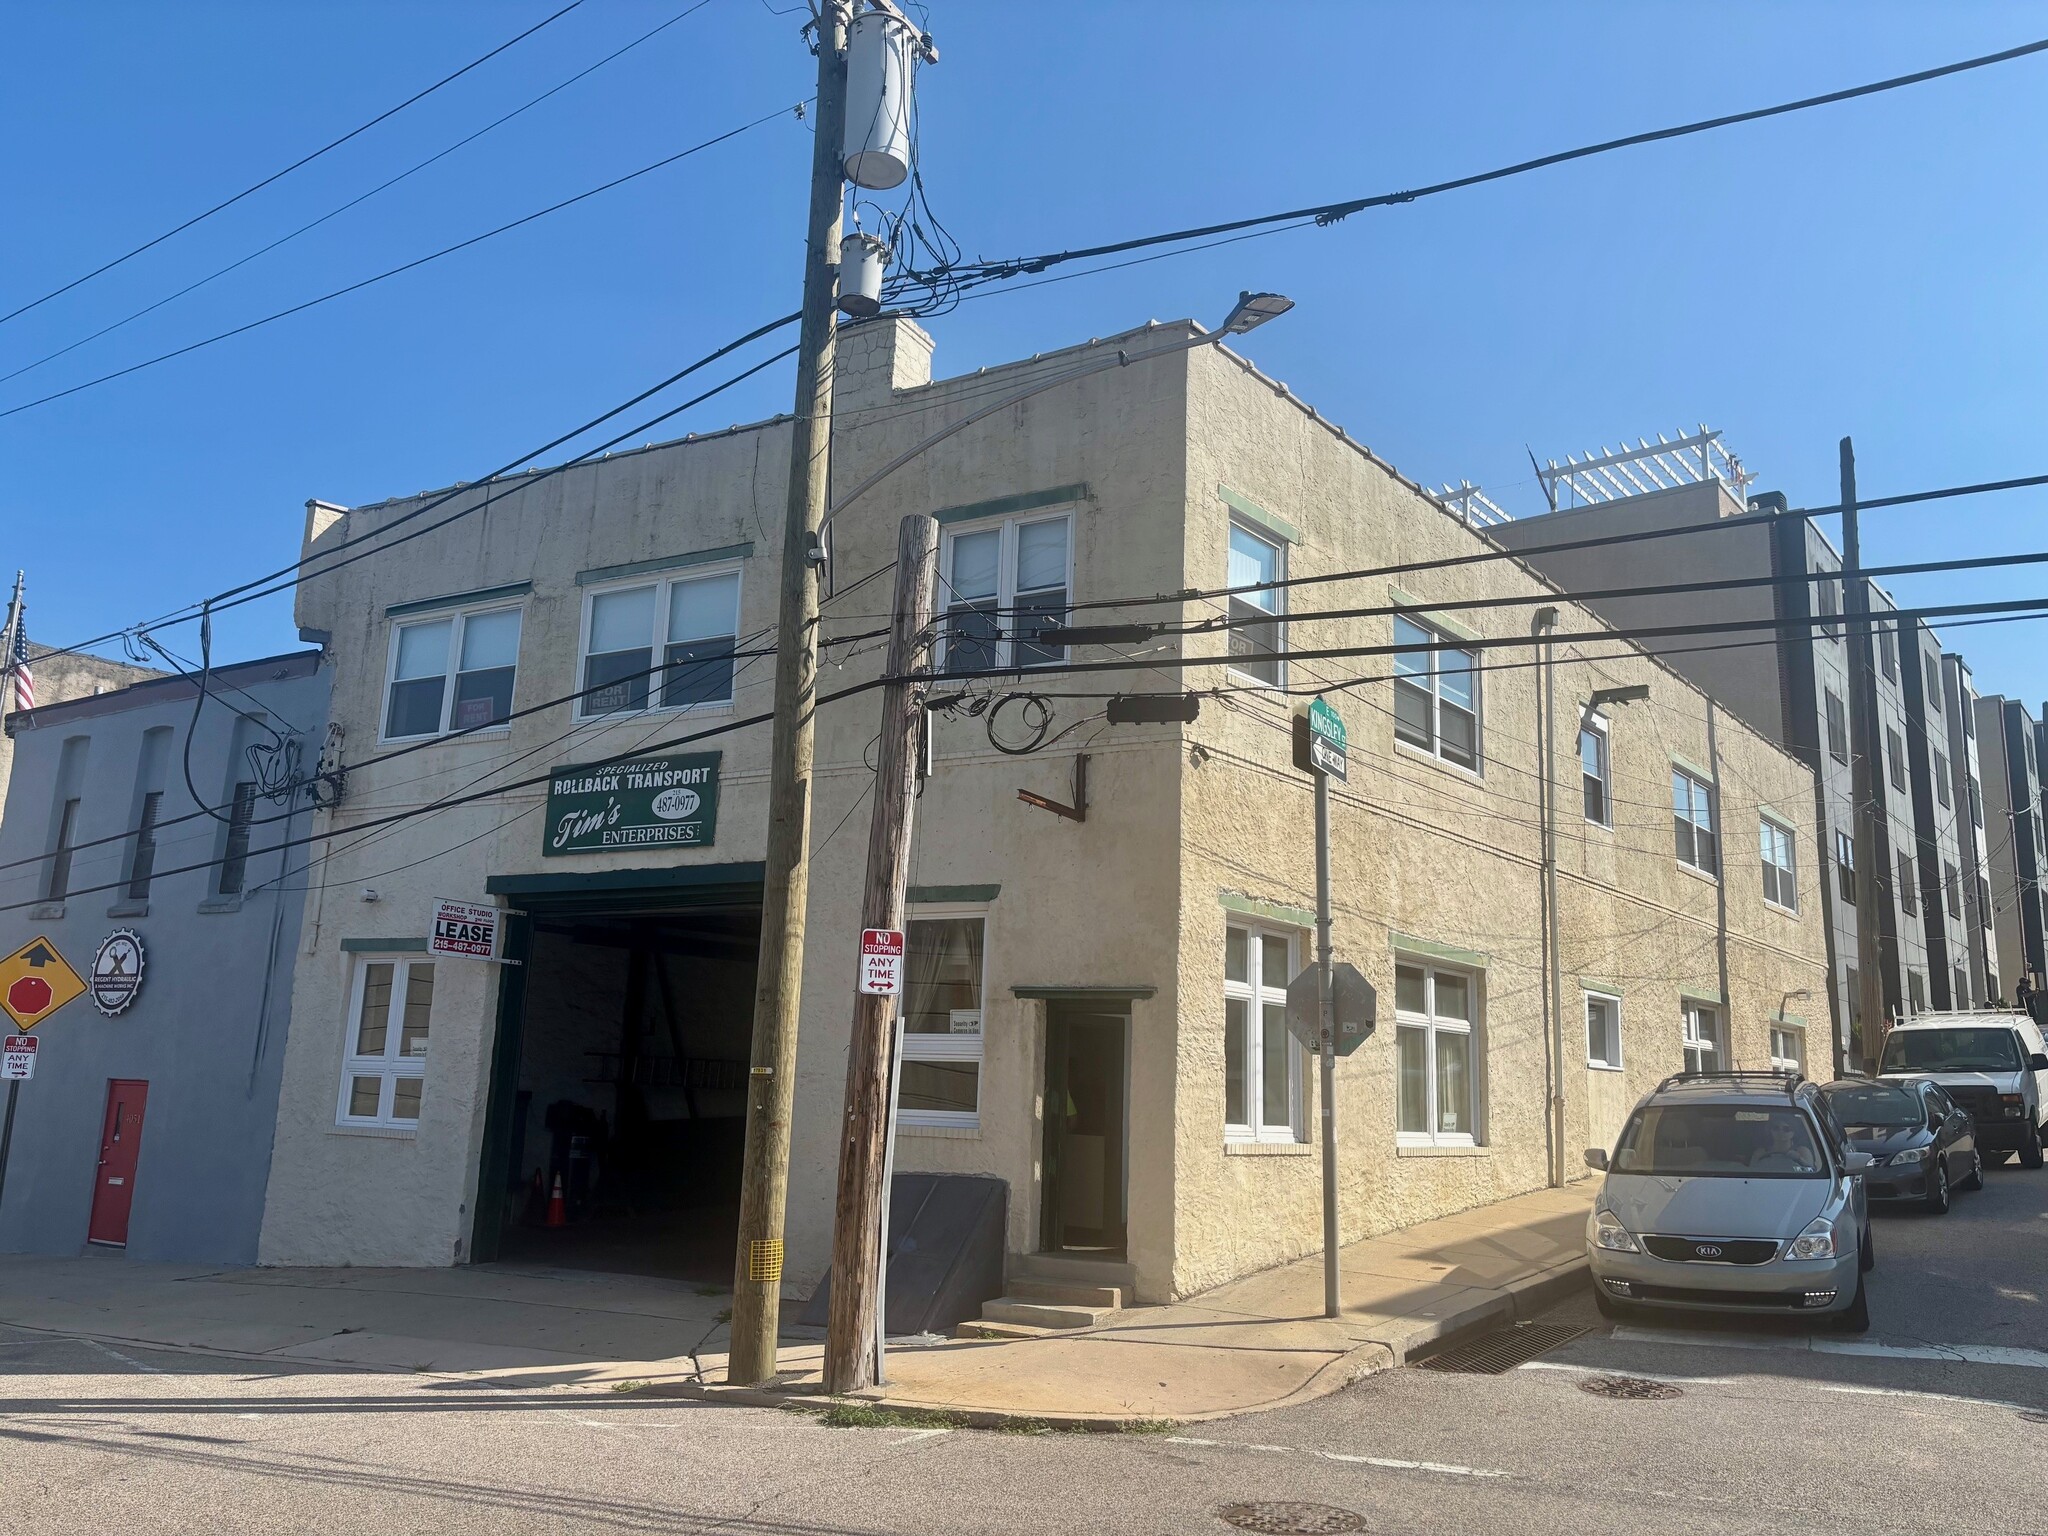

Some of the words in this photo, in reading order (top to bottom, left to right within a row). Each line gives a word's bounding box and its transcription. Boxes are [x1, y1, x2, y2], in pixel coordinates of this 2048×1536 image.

[597, 685, 622, 697] FOR
[467, 703, 485, 712] FOR
[592, 695, 626, 708] RENT
[463, 712, 488, 724] RENT
[1311, 707, 1341, 741] KINGSLEY
[596, 762, 668, 776] SPECIALIZED
[554, 775, 619, 795] ROLLBACK
[627, 768, 710, 789] TRANSPORT
[656, 795, 695, 812] 487-0977
[553, 797, 621, 848] Tim's
[602, 825, 694, 844] ENTERPRISES
[438, 912, 467, 920] WORKSHOP
[442, 904, 465, 914] OFFICE
[468, 908, 493, 918] STUDIO
[435, 920, 493, 943] LEASE
[876, 932, 891, 945] NO
[434, 939, 491, 954] 215-487-0977
[864, 944, 901, 955] STOPPING
[868, 957, 895, 968] ANY
[868, 968, 895, 980] TIME
[15, 1037, 28, 1046] NO
[1700, 1247, 1718, 1255] KIA
